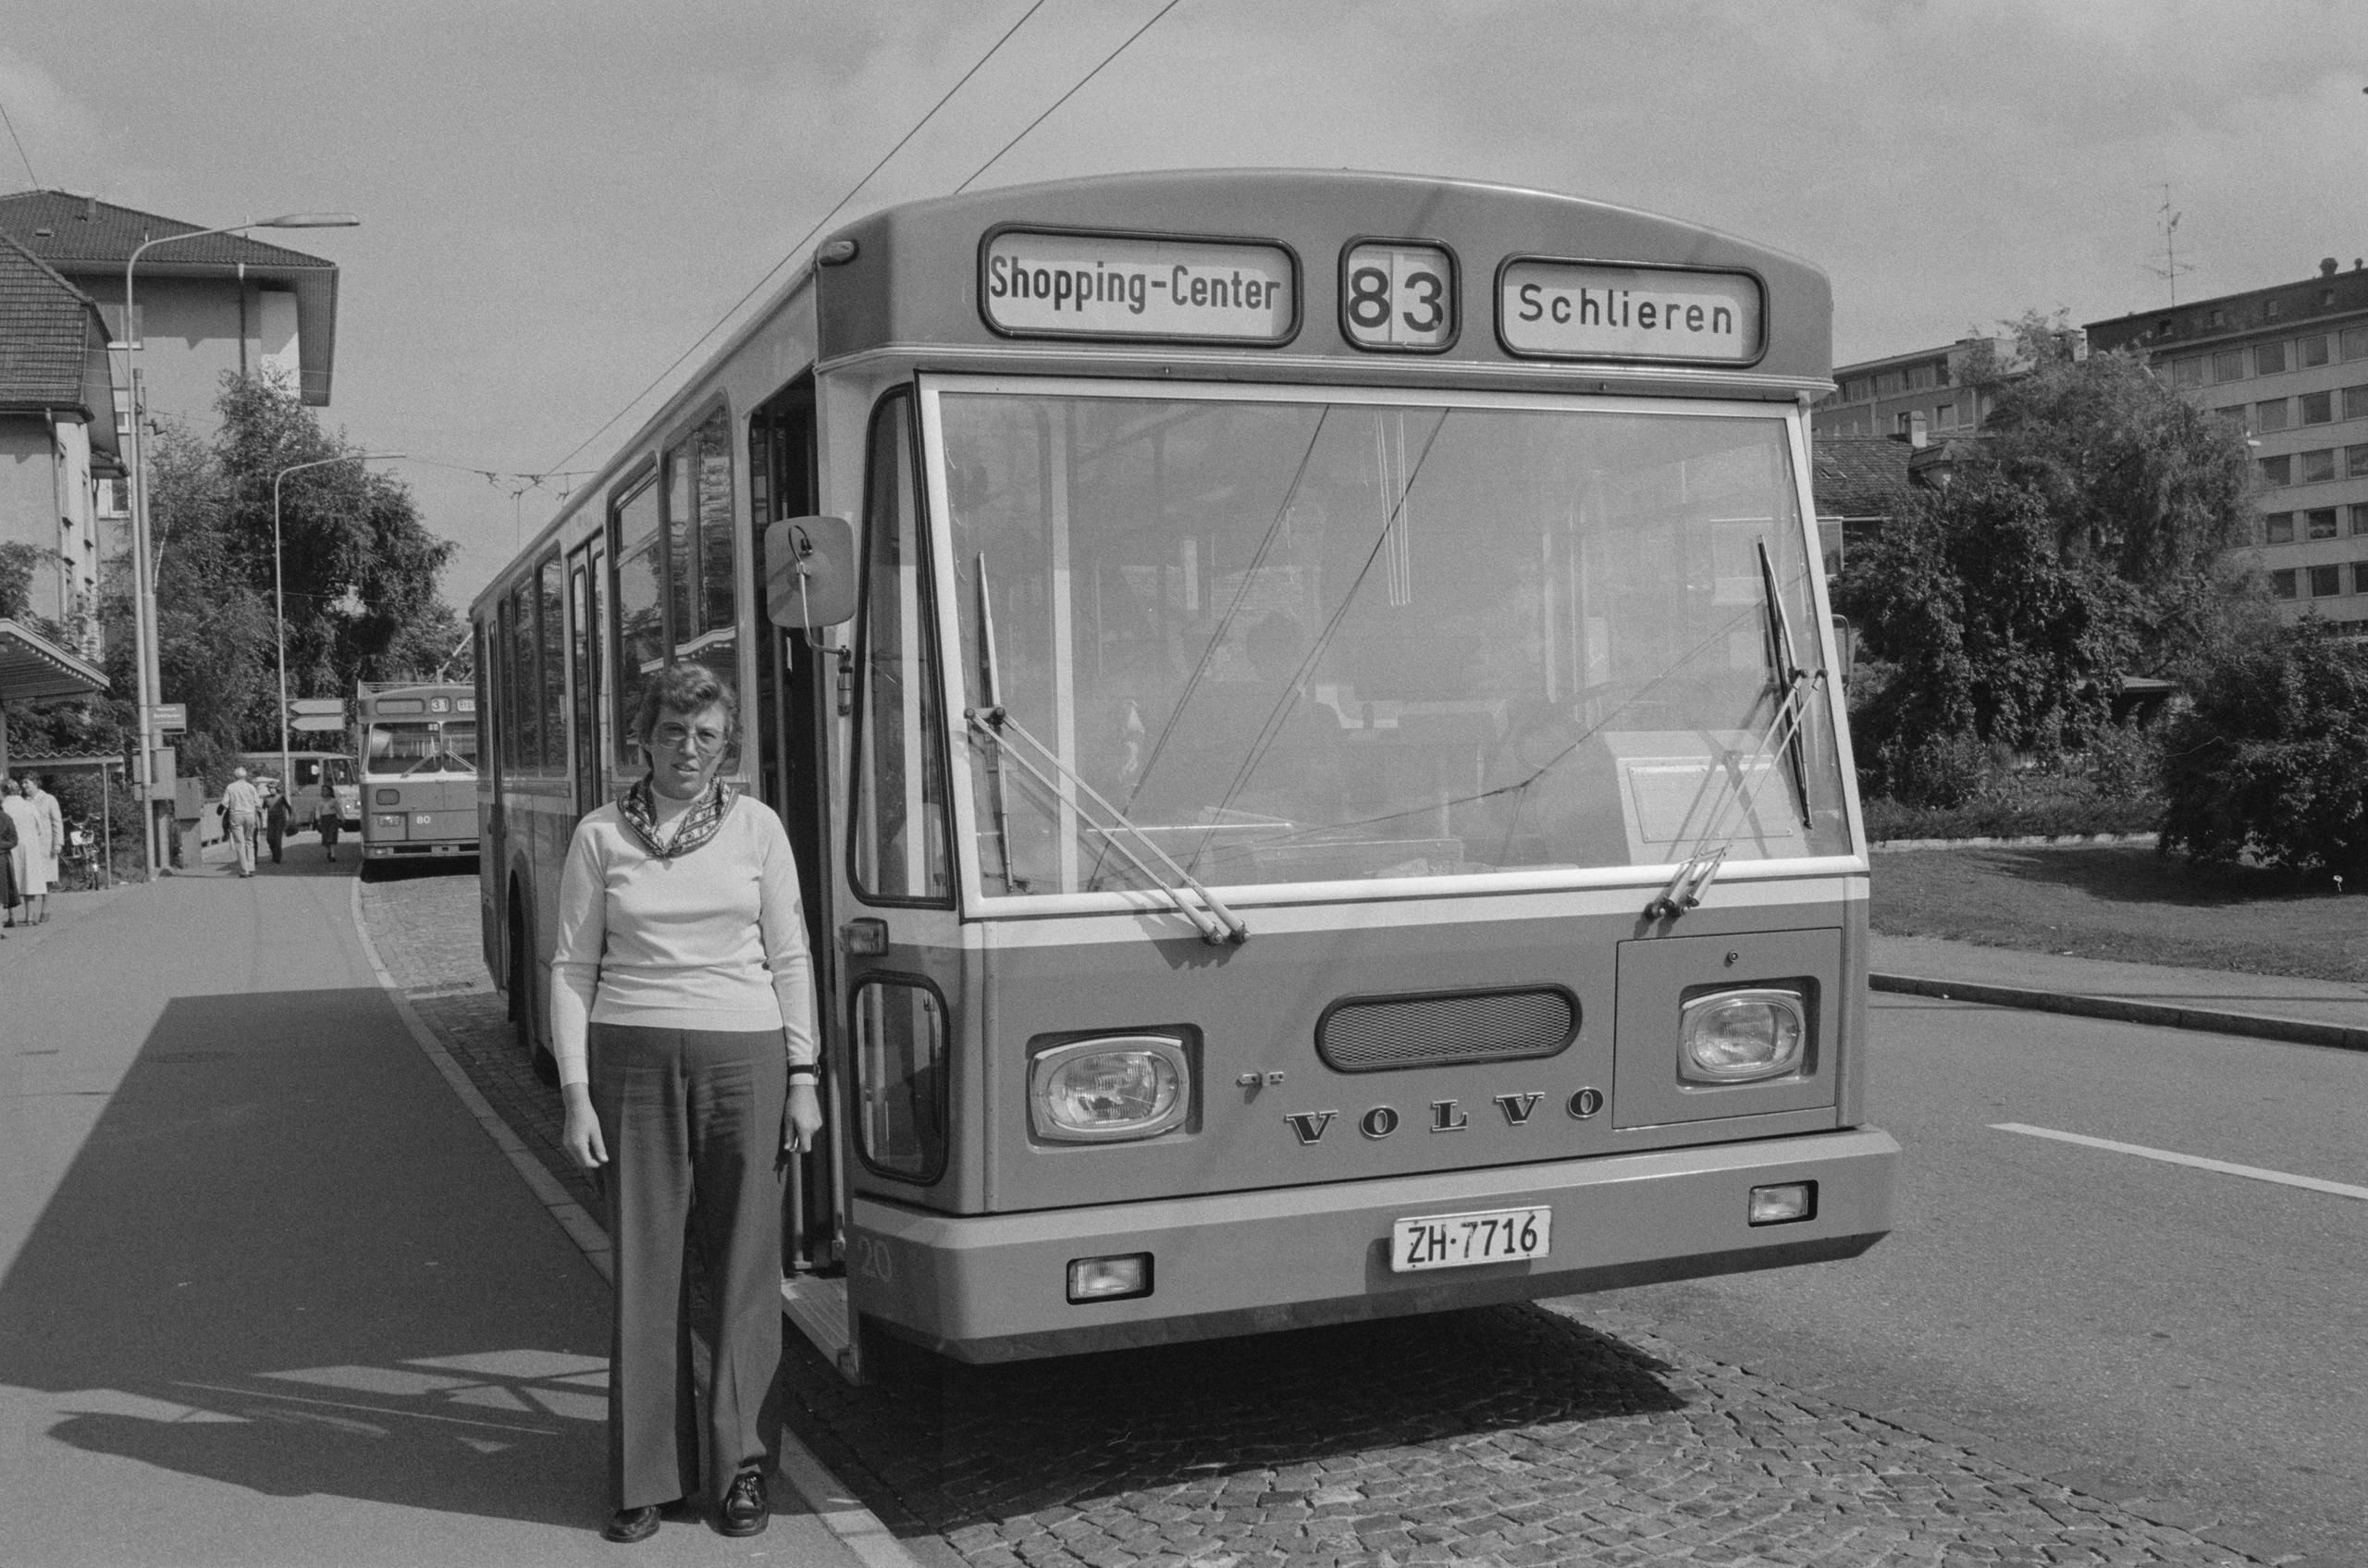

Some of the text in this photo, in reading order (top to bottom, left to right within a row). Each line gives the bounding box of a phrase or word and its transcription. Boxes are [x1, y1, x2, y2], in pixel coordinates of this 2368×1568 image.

[990, 255, 1280, 315] Shopping-Center
[1349, 266, 1443, 332] 83
[1519, 283, 1732, 334] Schlieren
[432, 699, 447, 710] 31
[416, 815, 430, 824] 80
[1286, 1086, 1604, 1144] VOLVO
